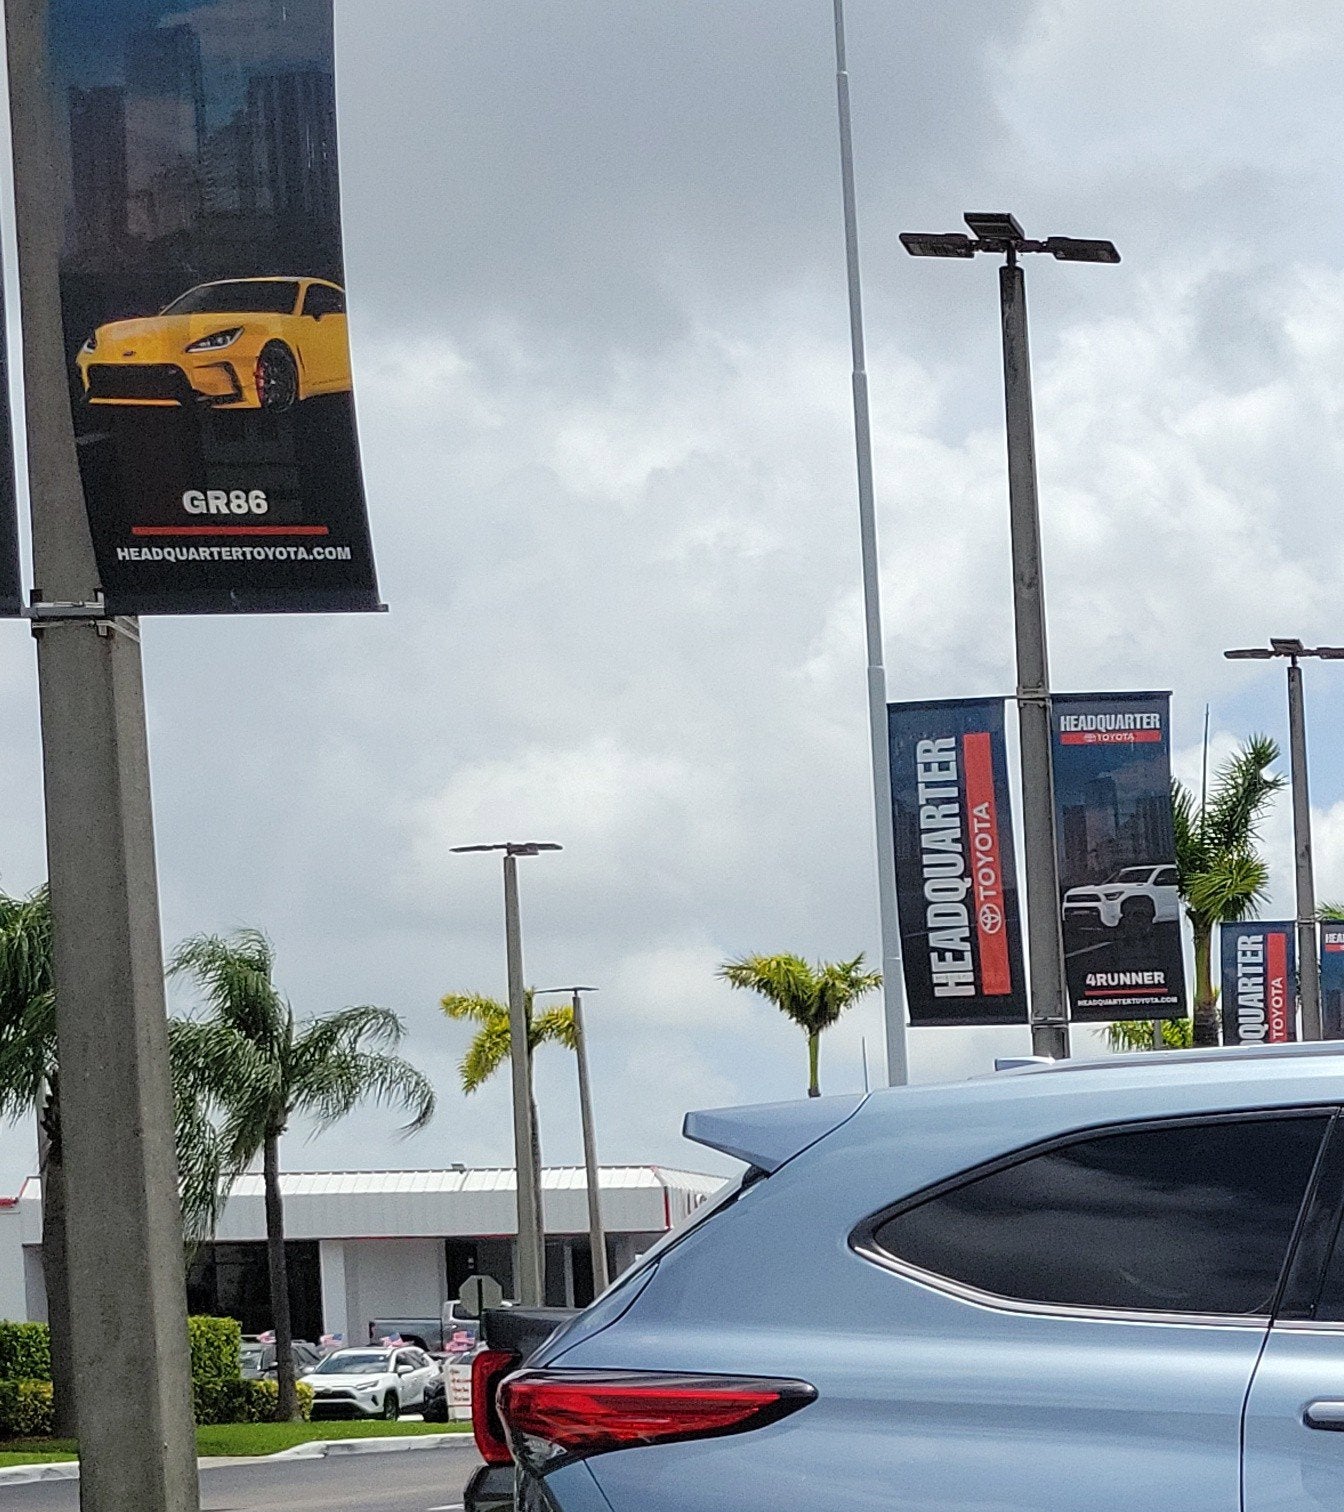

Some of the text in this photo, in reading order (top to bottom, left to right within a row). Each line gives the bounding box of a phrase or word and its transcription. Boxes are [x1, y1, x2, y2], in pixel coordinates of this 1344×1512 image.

[182, 489, 269, 515] GR86
[116, 546, 352, 562] HEADQUARTERTOYOTA.COM
[1060, 713, 1160, 733] HEADQUARTER
[1097, 732, 1135, 742] TOYOTA
[973, 801, 998, 901] TOYOTA
[916, 735, 973, 998] HEADQUARTER
[1086, 971, 1165, 986] 4RUNNER
[1237, 934, 1269, 1045] QUARTER
[1270, 976, 1284, 1040] TOYOTA
